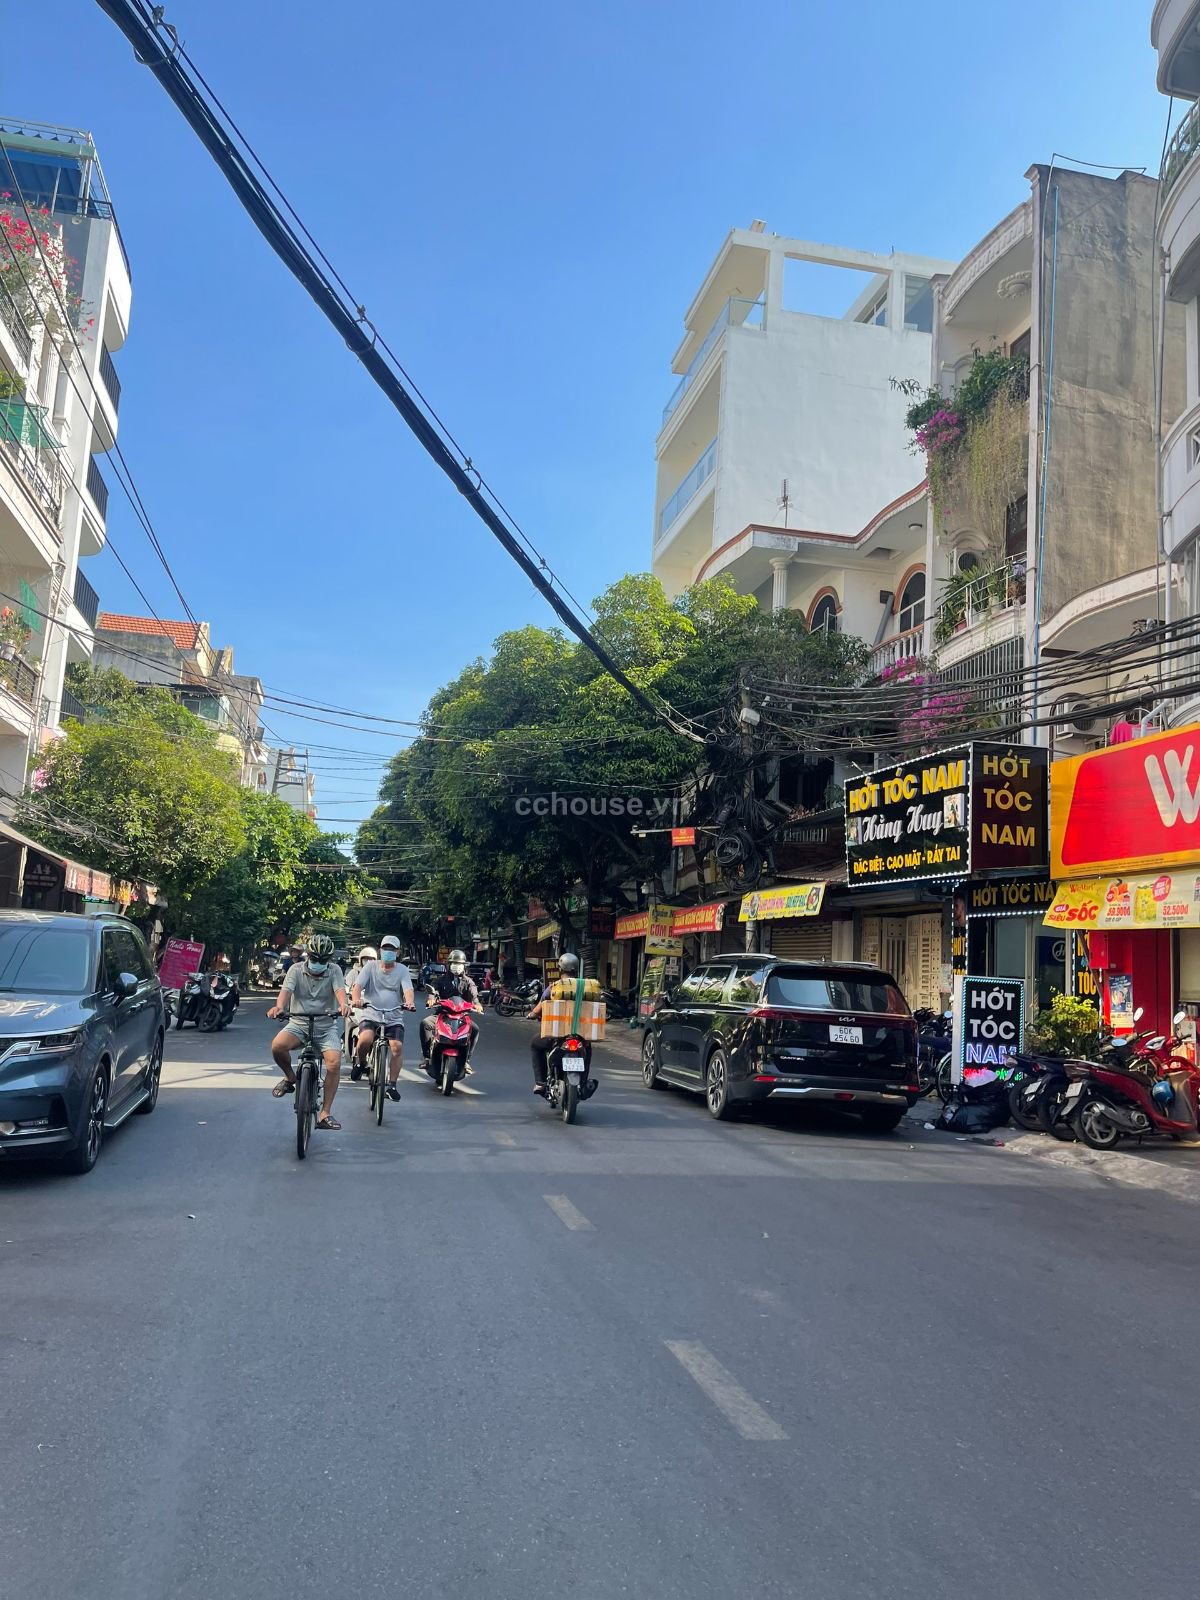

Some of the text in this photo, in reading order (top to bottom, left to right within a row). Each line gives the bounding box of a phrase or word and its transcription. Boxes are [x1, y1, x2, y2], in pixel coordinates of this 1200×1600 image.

[983, 748, 1031, 778] HỚT
[849, 760, 966, 813] HỚT TÓC NAM
[983, 781, 1033, 812] TÓC
[906, 803, 943, 836] Huy
[981, 822, 1036, 847] NAM
[886, 855, 904, 873] CẠO
[945, 846, 960, 861] TAI
[972, 881, 998, 907] HỚT
[1001, 878, 1031, 904] TÓC
[1066, 901, 1099, 921] SỐC
[971, 986, 1015, 1011] HỚT
[969, 1015, 1015, 1040] TÓC
